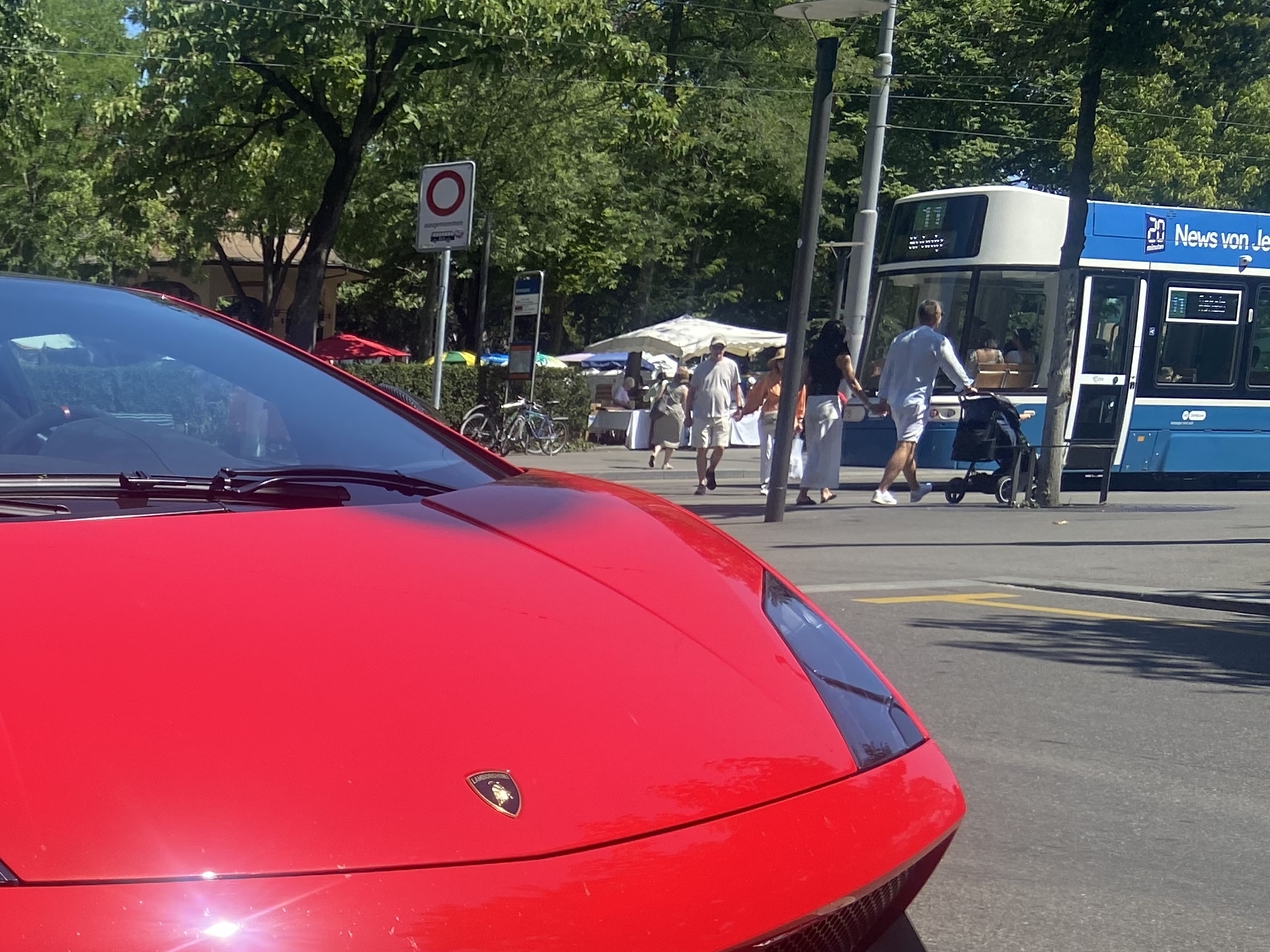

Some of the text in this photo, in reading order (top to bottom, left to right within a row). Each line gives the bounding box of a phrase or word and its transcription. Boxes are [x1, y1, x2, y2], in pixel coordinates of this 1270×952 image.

[1147, 216, 1166, 243] 20
[1174, 223, 1219, 249] News
[1221, 232, 1249, 250] von
